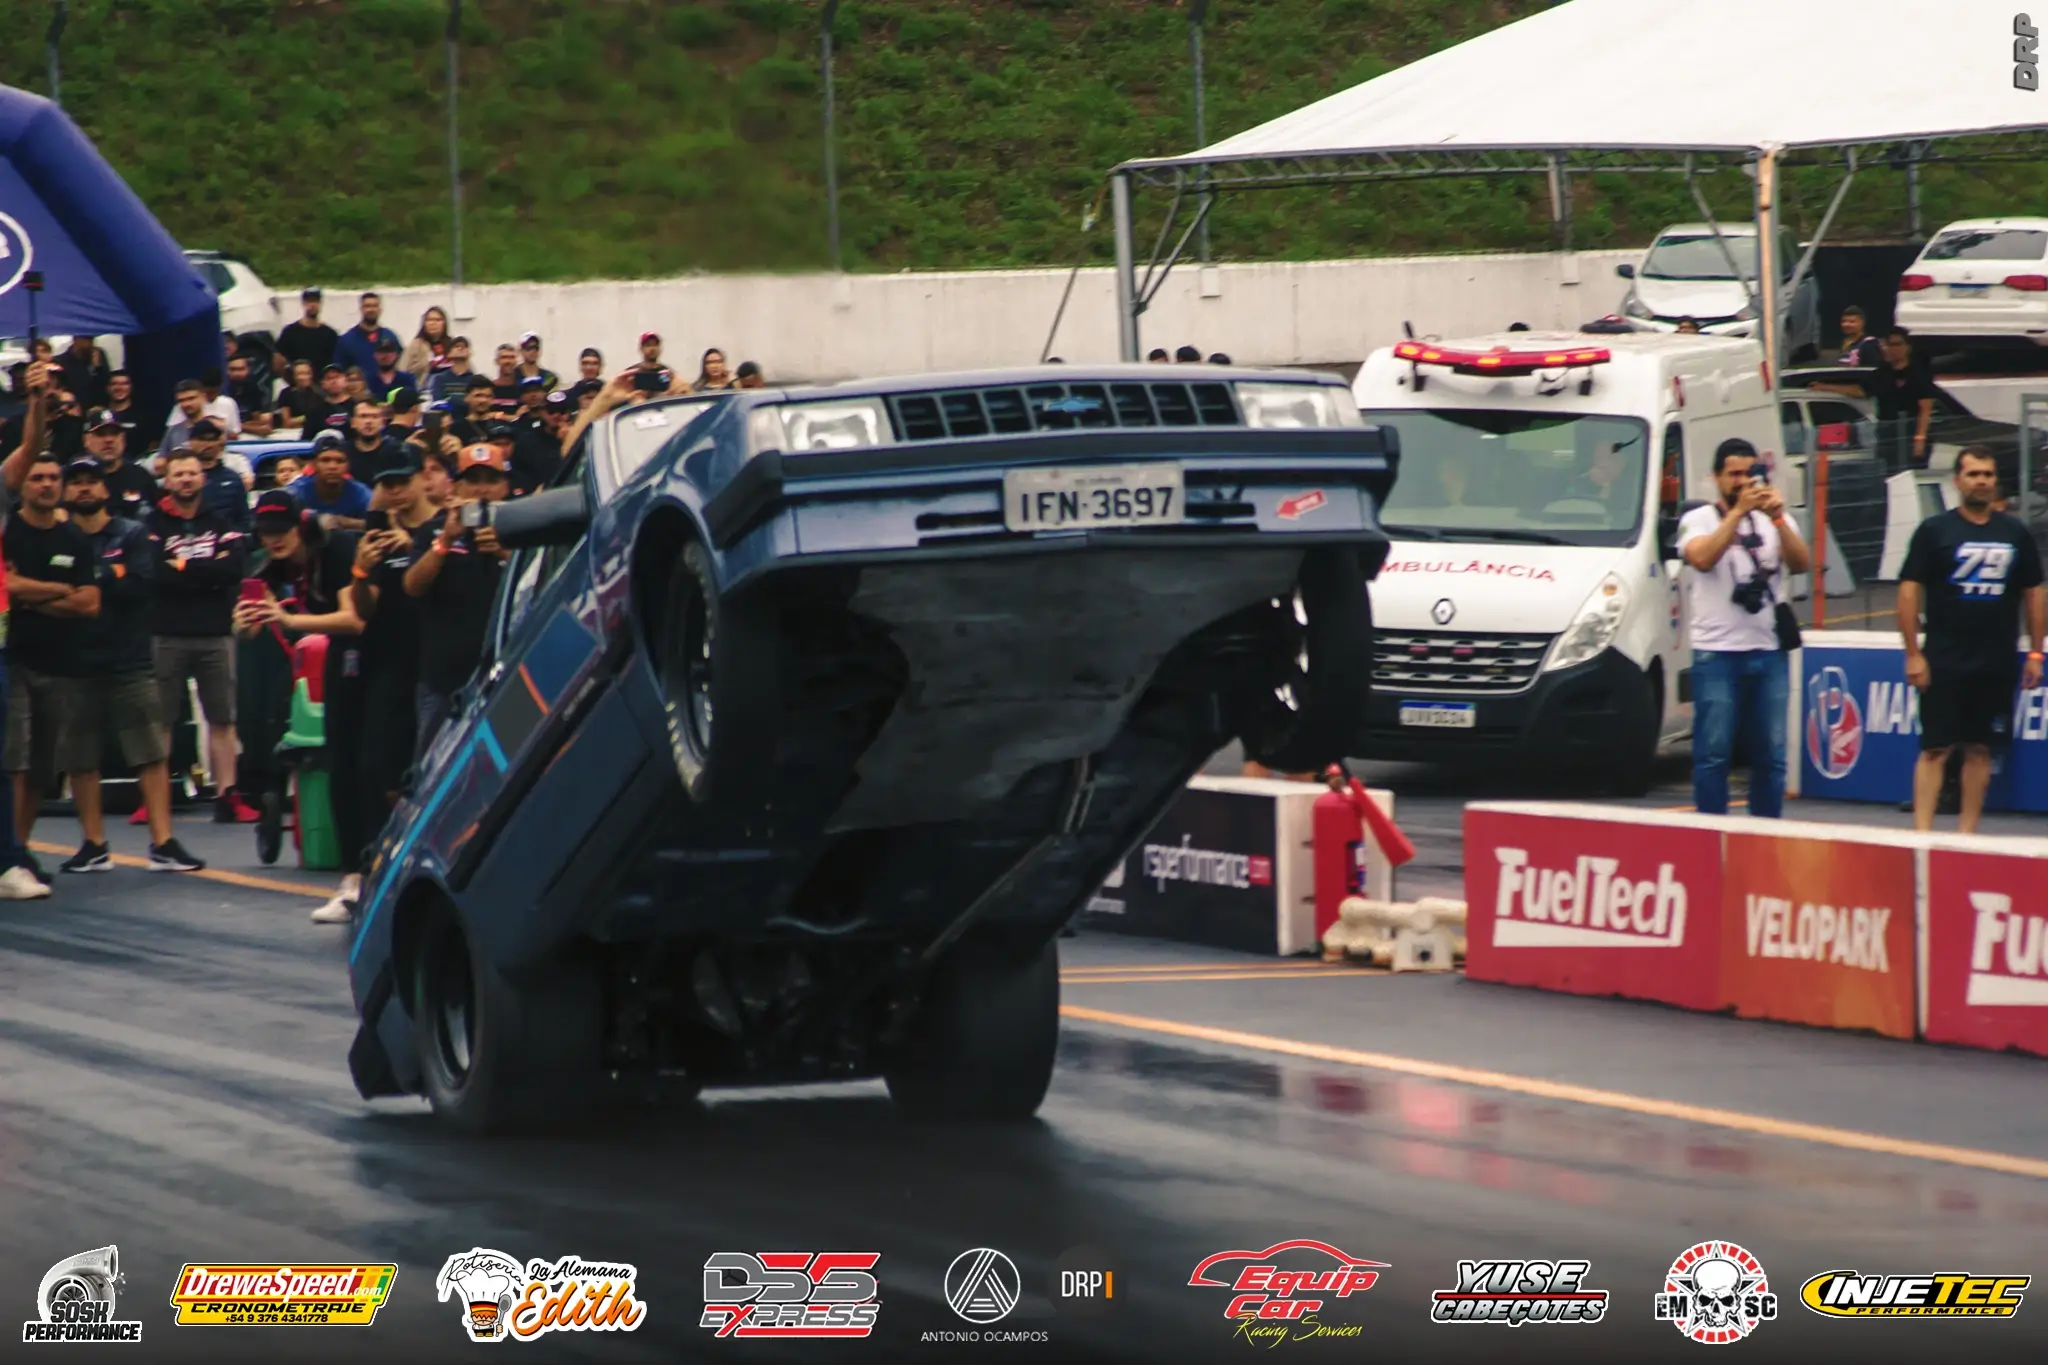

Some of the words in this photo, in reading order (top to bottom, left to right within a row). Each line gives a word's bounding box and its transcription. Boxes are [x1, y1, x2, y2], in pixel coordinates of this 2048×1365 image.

[1021, 486, 1175, 522] IFN-3697
[1381, 560, 1556, 583] MBULÂNCIA
[1952, 547, 2013, 580] 79
[1493, 847, 1687, 947] FuelTech
[1746, 894, 1891, 973] VELOPARK
[1968, 889, 2048, 976] Fu
